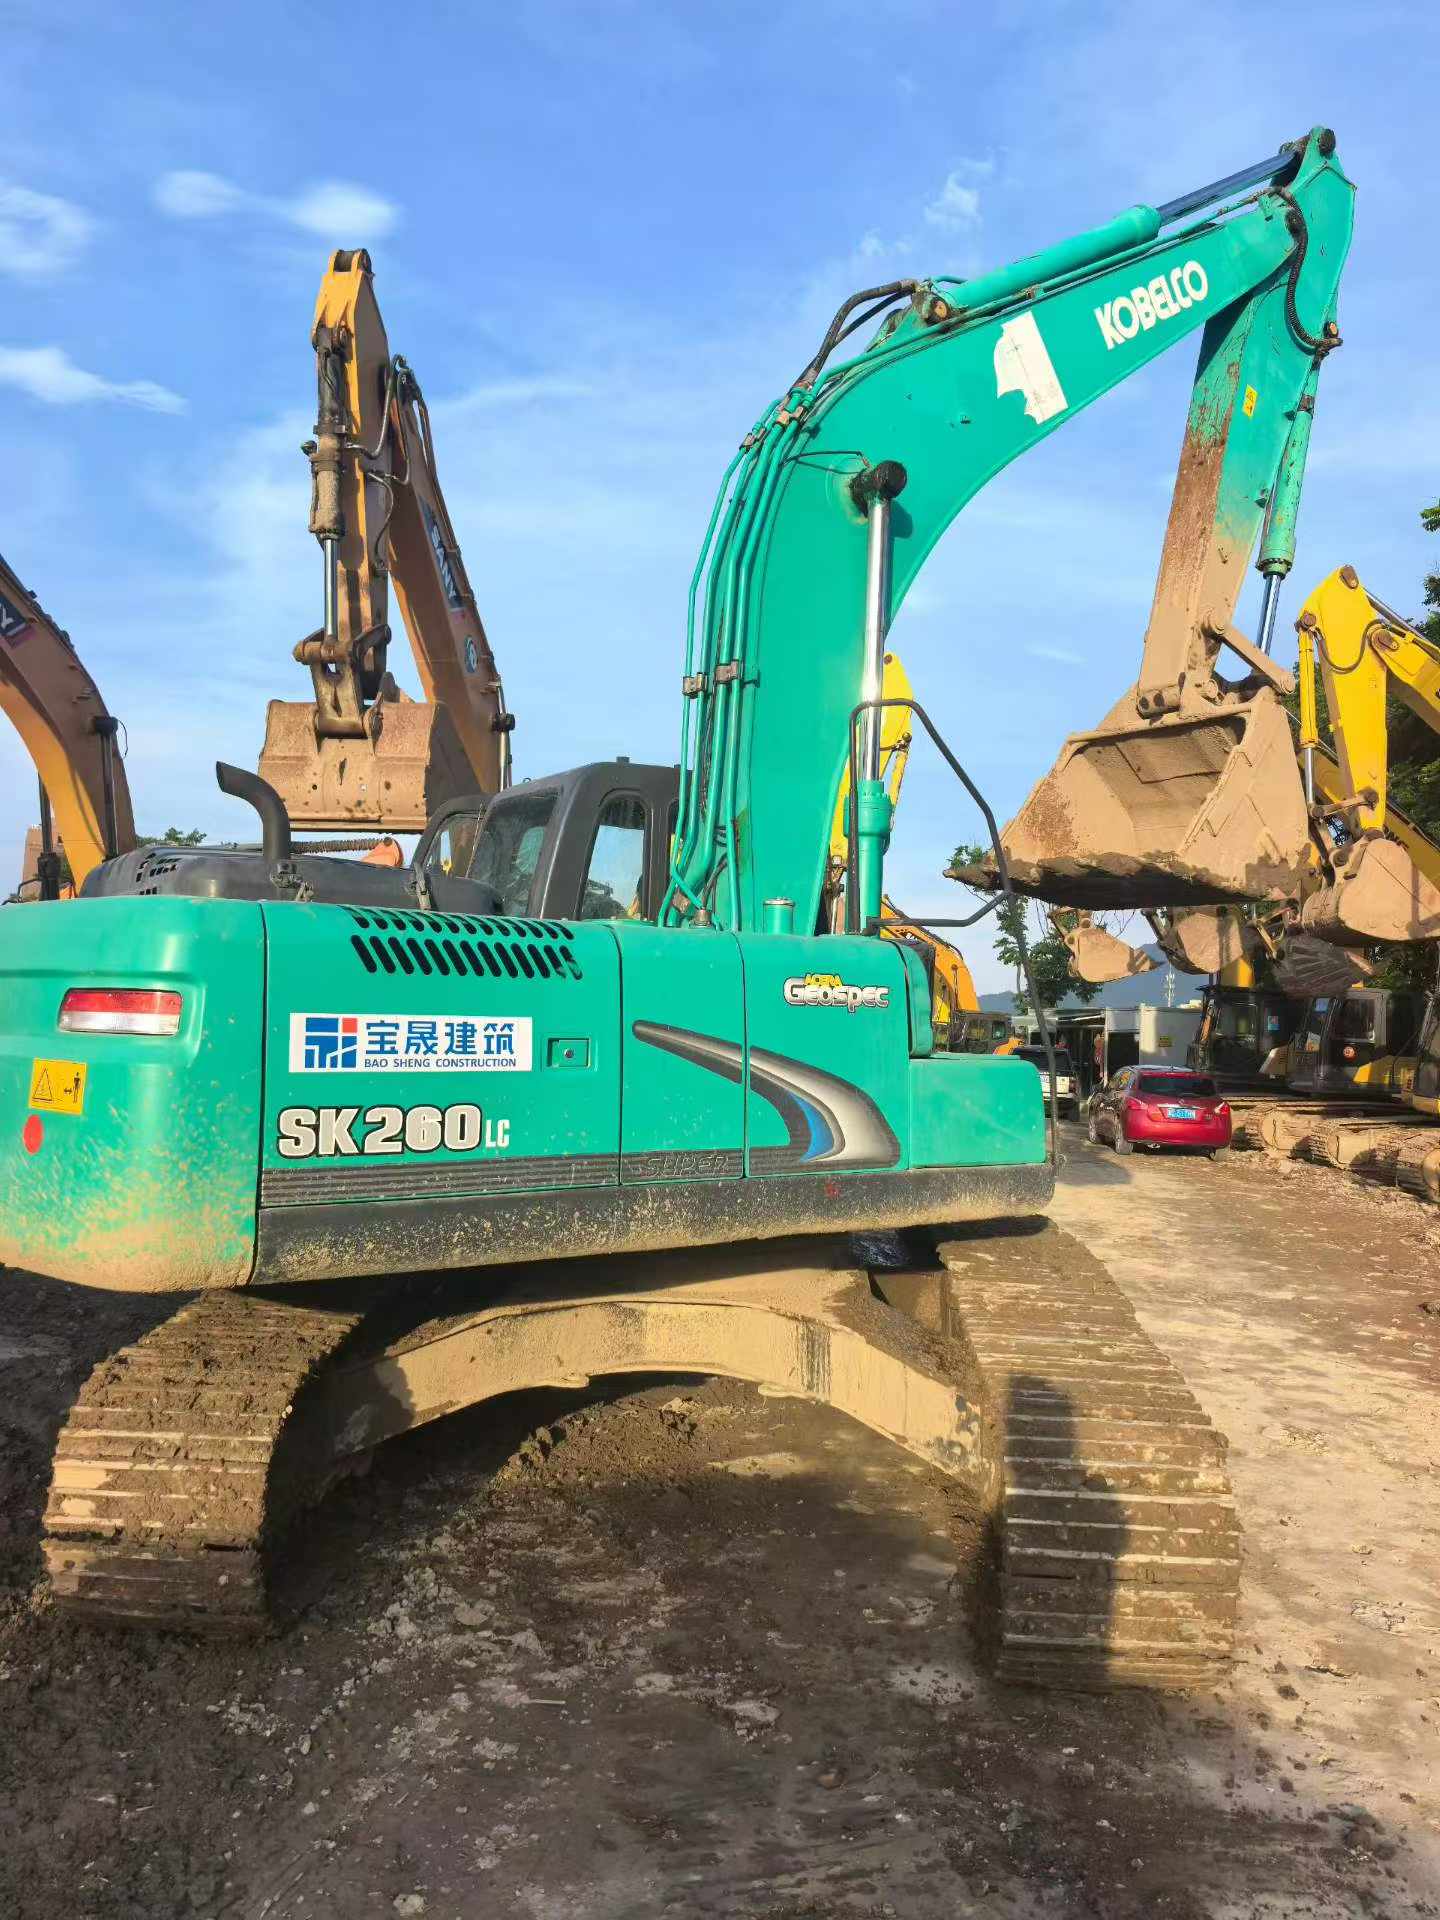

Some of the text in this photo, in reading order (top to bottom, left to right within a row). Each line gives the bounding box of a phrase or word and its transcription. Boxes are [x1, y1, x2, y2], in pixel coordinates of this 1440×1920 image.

[1093, 260, 1209, 351] KOBELCO
[365, 1020, 516, 1056] 宝晟建筑
[364, 1058, 517, 1068] BAO SHENG CONSTRUCTION
[279, 1103, 510, 1159] SK260 LC
[646, 1154, 730, 1178] SUPER
